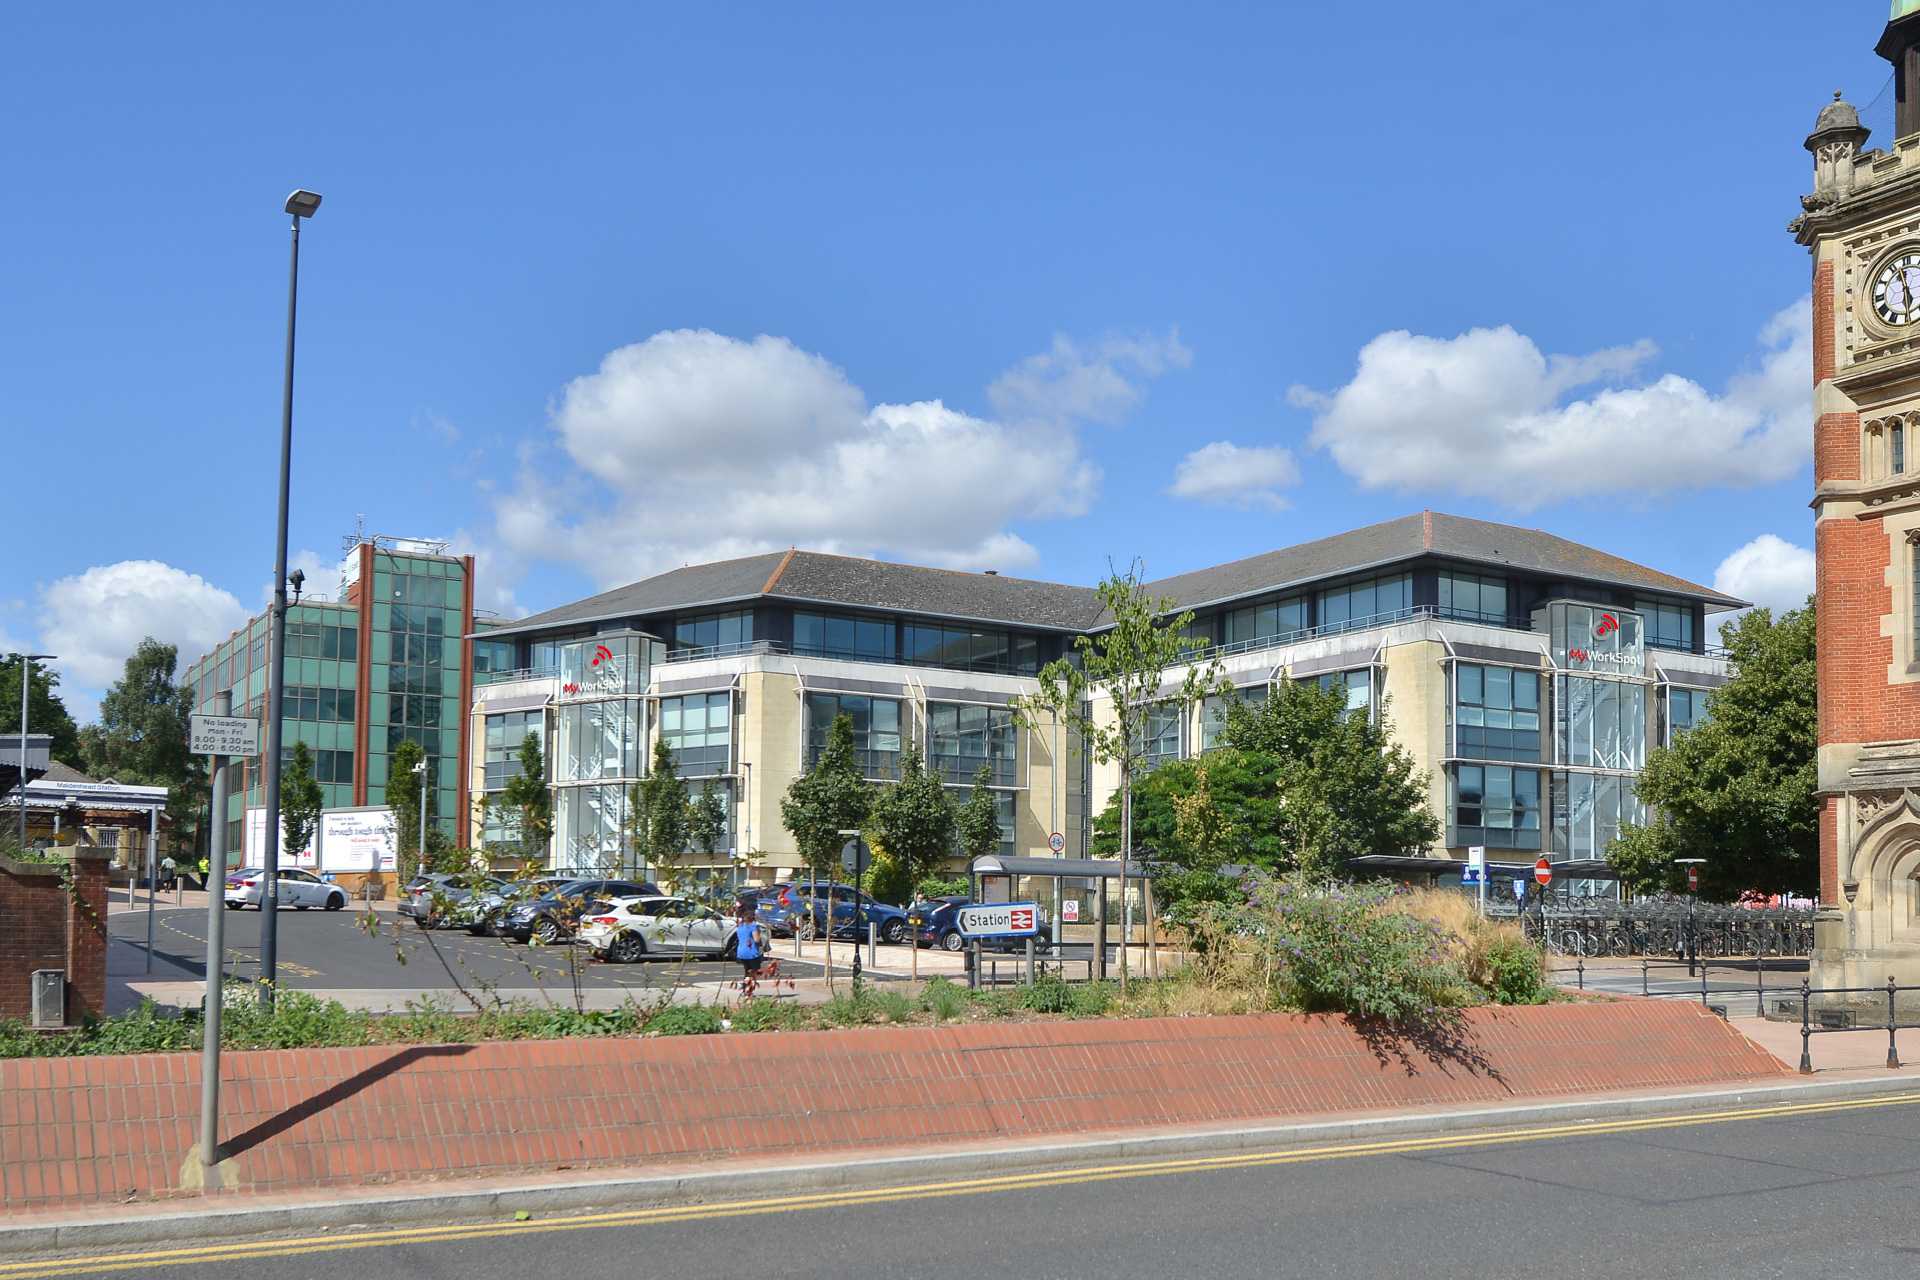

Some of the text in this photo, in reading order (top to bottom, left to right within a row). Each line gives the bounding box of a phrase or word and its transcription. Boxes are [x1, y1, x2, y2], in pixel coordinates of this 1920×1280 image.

[1569, 648, 1640, 665] MyWorkSpot
[217, 720, 247, 728] loading
[969, 913, 1010, 927] Station
